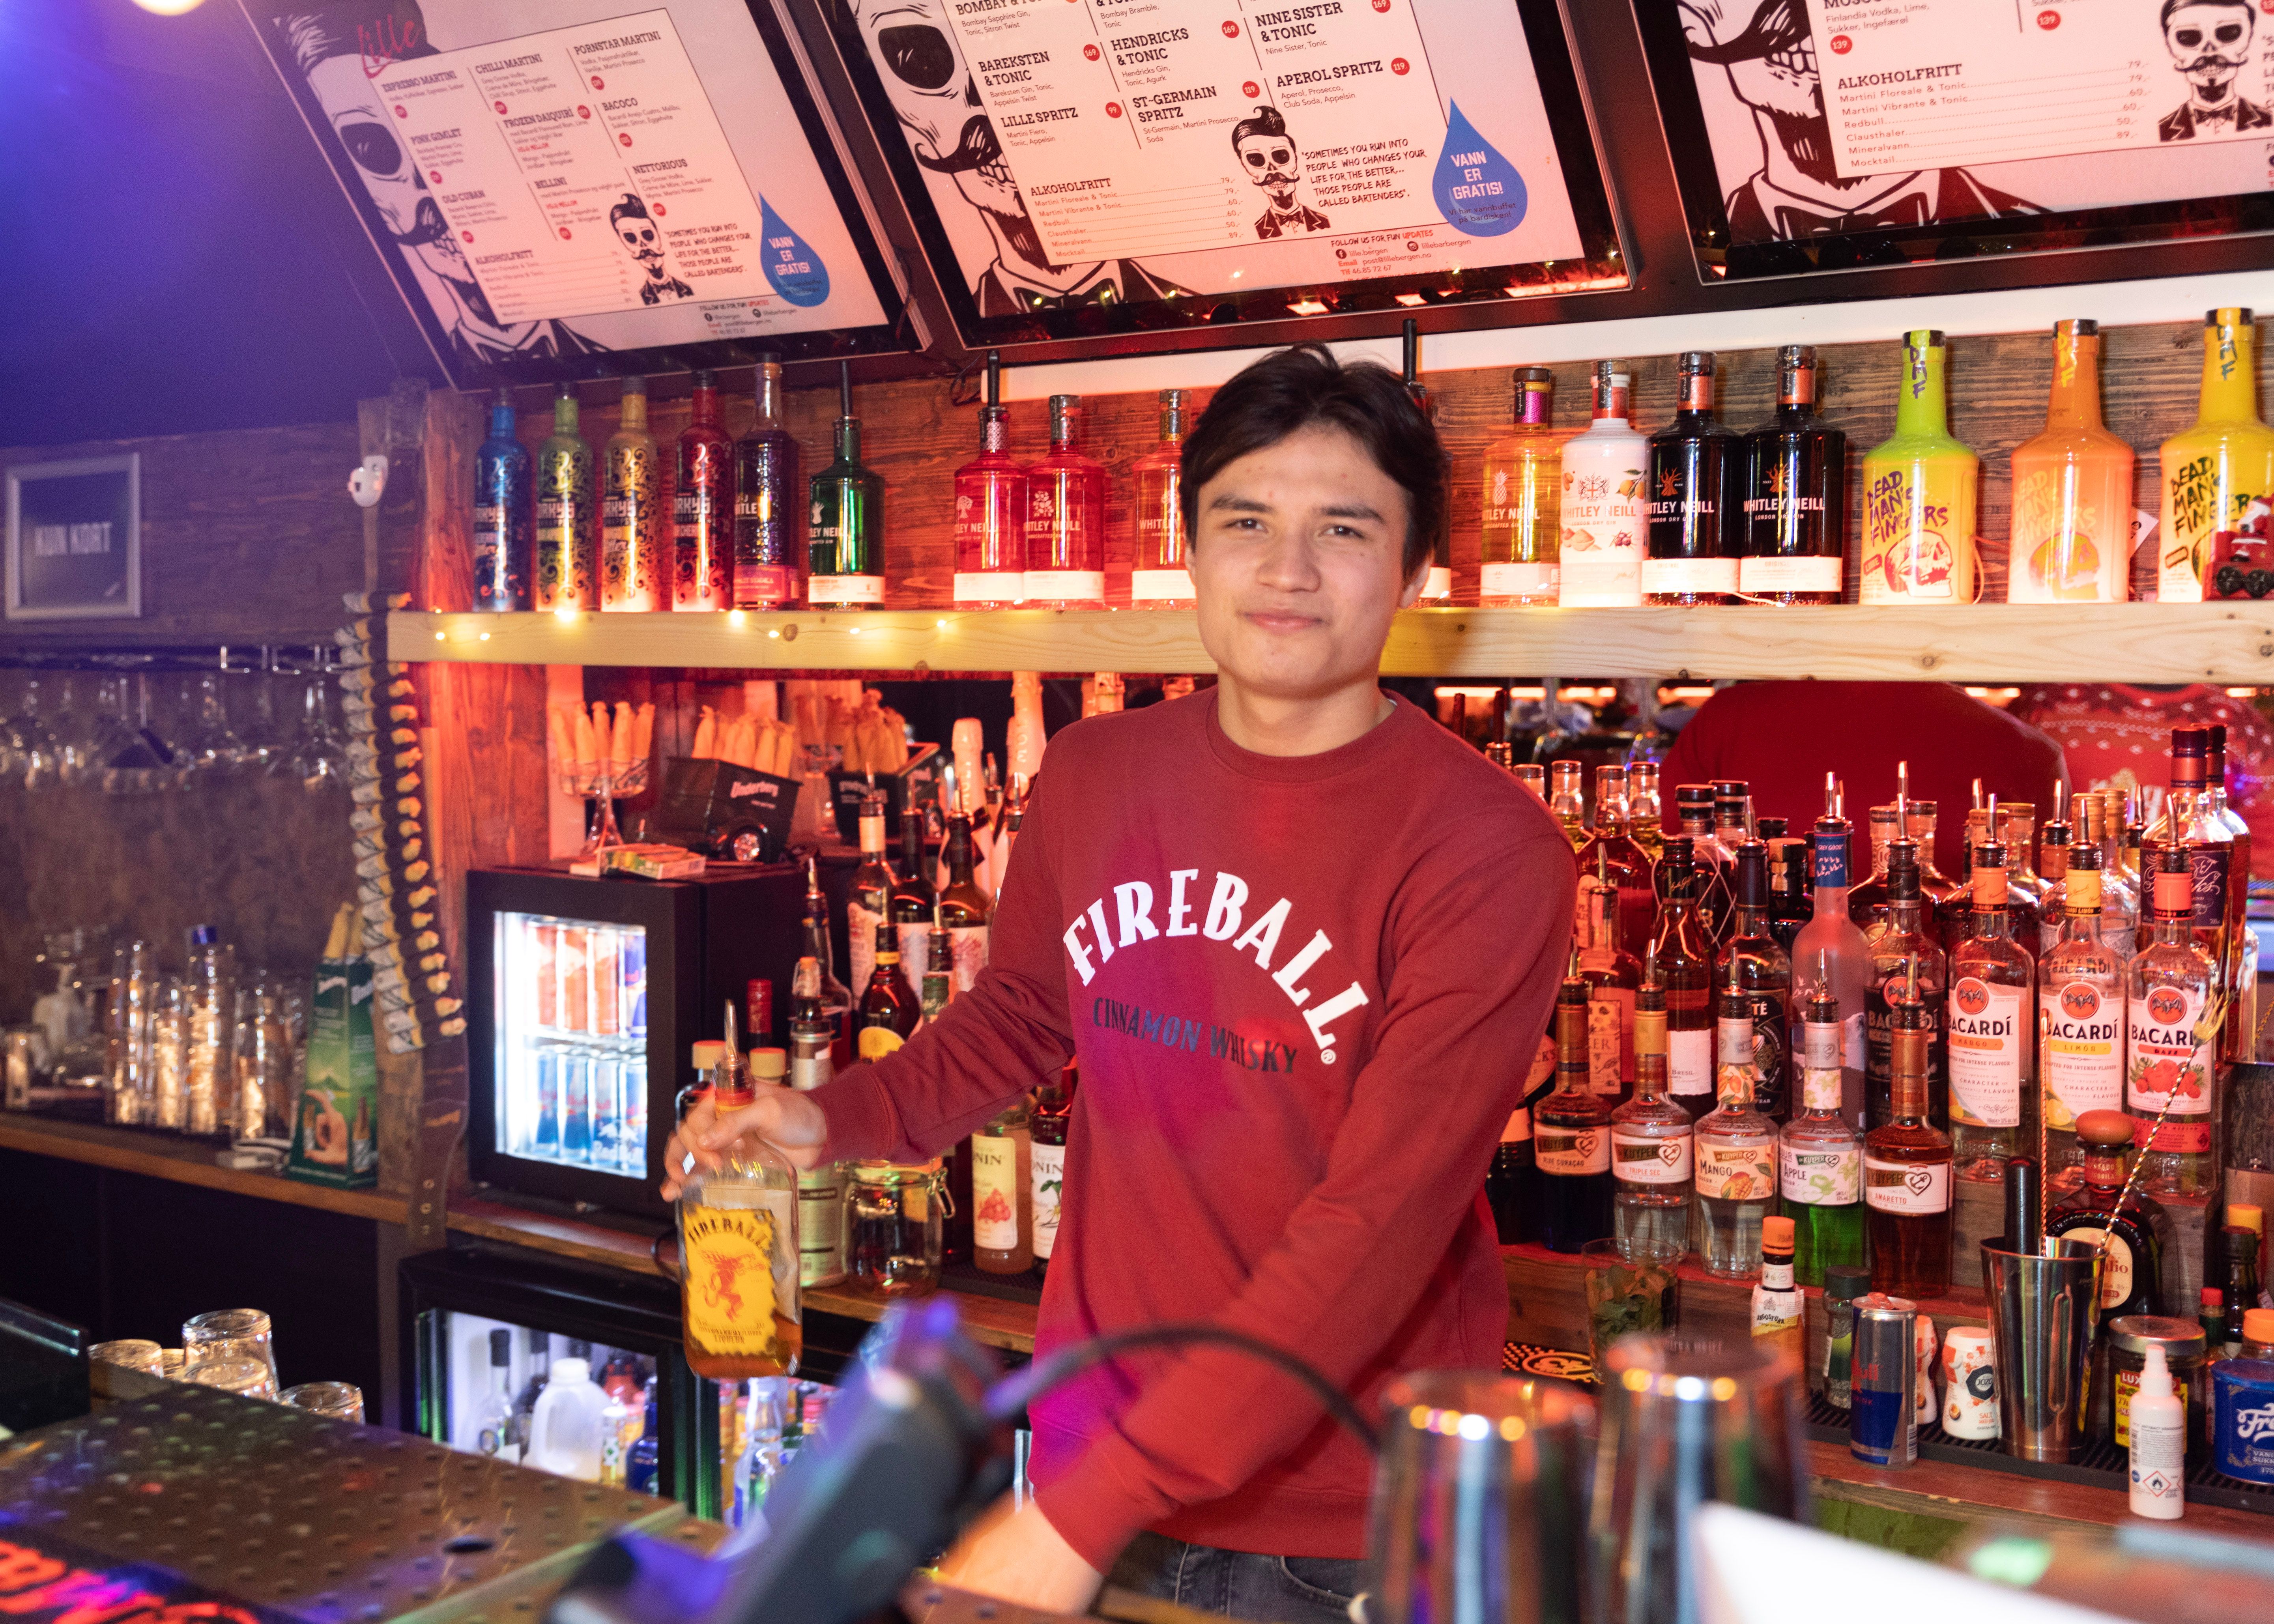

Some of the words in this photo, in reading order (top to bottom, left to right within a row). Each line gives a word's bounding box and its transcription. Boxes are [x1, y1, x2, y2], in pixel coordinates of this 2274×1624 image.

[1100, 9, 1128, 19] Bombay
[1129, 4, 1159, 15] Bramble,
[1255, 11, 1292, 27] NINE
[1294, 2, 1343, 20] SISTER
[1826, 11, 1867, 23] Finlandia
[1869, 7, 1902, 16] Vodka,
[1904, 4, 1930, 13] Lime,
[962, 18, 986, 27] Bombay
[987, 13, 1015, 23] Sapphire
[984, 24, 1003, 33] Sitron
[1260, 30, 1271, 42] &
[1271, 23, 1317, 40] TONIC
[1827, 25, 1861, 34] Sukker,
[574, 39, 620, 55] PORNSTAR
[621, 31, 661, 46] MARTINI
[1111, 28, 1189, 51] HENDRICKS
[1285, 43, 1307, 52] Sister,
[1307, 40, 1328, 48] Tonic
[503, 54, 542, 69] MARTINI
[978, 51, 1050, 72] BAREKSTEN
[1117, 54, 1126, 66] &
[1125, 48, 1169, 64] TONIC
[985, 75, 994, 86] &
[993, 70, 1032, 85] TONIC
[1122, 67, 1155, 78] Hendricks
[1156, 65, 1171, 74] Gin,
[1277, 69, 1332, 87] APEROL
[1333, 60, 1383, 78] SPRITZ
[1838, 63, 1962, 90] ALKOHOLFRITT
[1146, 75, 1167, 85] Agurk
[989, 87, 1020, 98] Bareksten
[1281, 90, 1307, 99] Aperol,
[1309, 85, 1344, 95] Prosecco,
[1840, 92, 1876, 103] Martini
[1880, 87, 1922, 99] Floreale
[1939, 81, 1967, 91] Tonic
[602, 97, 638, 111] BACOCO
[994, 97, 1020, 107] Appelsin
[1284, 99, 1301, 108] Club
[1302, 97, 1322, 106] Soda,
[1324, 92, 1356, 103] Appelsin
[1842, 105, 1878, 116] Martini
[1882, 100, 1925, 112] Vibrante
[1941, 95, 1968, 104] Tonic
[1000, 112, 1035, 127] LILLE
[1036, 107, 1079, 123] SPRITZ
[1138, 106, 1184, 123] SPRITZ
[1183, 119, 1207, 129] Martini
[1845, 118, 1884, 129] Redbull
[1006, 130, 1029, 139] Martini
[1029, 135, 1056, 145] Appelsin
[1846, 130, 1905, 142] Clausthaler
[1350, 144, 1368, 153] YOU
[1369, 142, 1386, 151] RUN
[1388, 138, 1408, 149] INTO
[1849, 142, 1909, 154] Mineralvann
[632, 158, 687, 174] NETTORIOUS
[1306, 161, 1337, 172] PEOPLE
[1342, 158, 1360, 167] WHO
[1362, 153, 1401, 164] CHANGES
[1403, 149, 1427, 159] YOUR
[1450, 151, 1487, 167] VANN
[1851, 156, 1894, 167] Mocktail
[1310, 176, 1328, 184] LIFE
[1330, 172, 1347, 182] FOR
[1347, 170, 1363, 180] THE
[1464, 168, 1482, 182] ER
[1031, 178, 1112, 196] ALKOHOLFRITT
[1313, 187, 1340, 196] THOSE
[1342, 183, 1373, 193] PEOPLE
[1376, 179, 1392, 188] ARE
[1453, 181, 1504, 200] GRATIS!
[1035, 198, 1059, 207] Martini
[1318, 197, 1350, 207] CALLED
[1474, 202, 1516, 213] vannbuffet
[768, 236, 795, 249] VANN
[1331, 238, 1359, 247] FOLLOW
[1402, 230, 1434, 240] UPDATES
[780, 250, 795, 261] ER
[775, 262, 811, 275] GRATIS!
[1063, 869, 1369, 1050] FIREBALL
[1093, 997, 1202, 1053] CINNAMON
[1210, 1025, 1298, 1074] WHISKY
[1874, 1193, 1907, 1204] AMARETTO
[688, 1217, 769, 1250] FIREBALL
